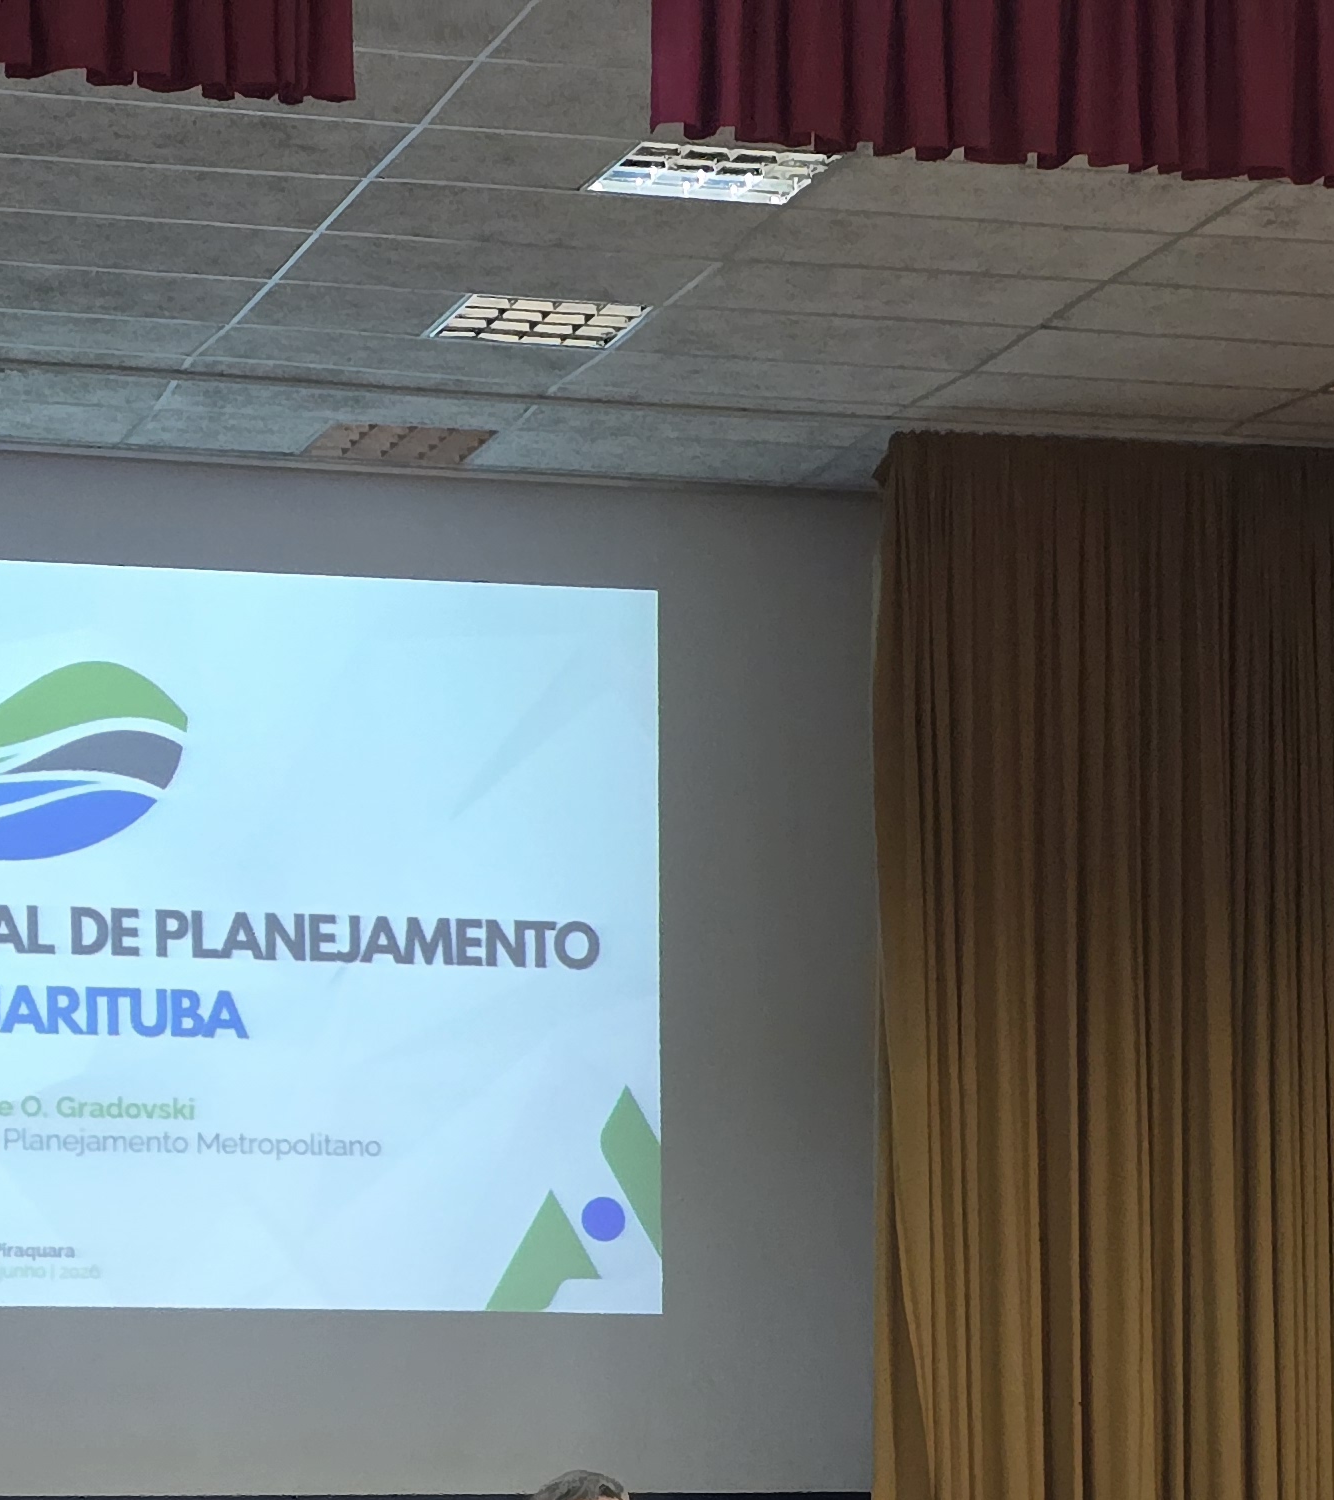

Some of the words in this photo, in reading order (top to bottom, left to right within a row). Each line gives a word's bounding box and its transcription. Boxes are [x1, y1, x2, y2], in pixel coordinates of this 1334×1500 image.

[70, 906, 140, 957] DE
[155, 909, 600, 970] PLANEJAMENTO
[21, 1096, 48, 1117] O.
[56, 1096, 195, 1120] Gradovski
[3, 1128, 188, 1156] Planejamento
[196, 1132, 382, 1160] Metropolitano
